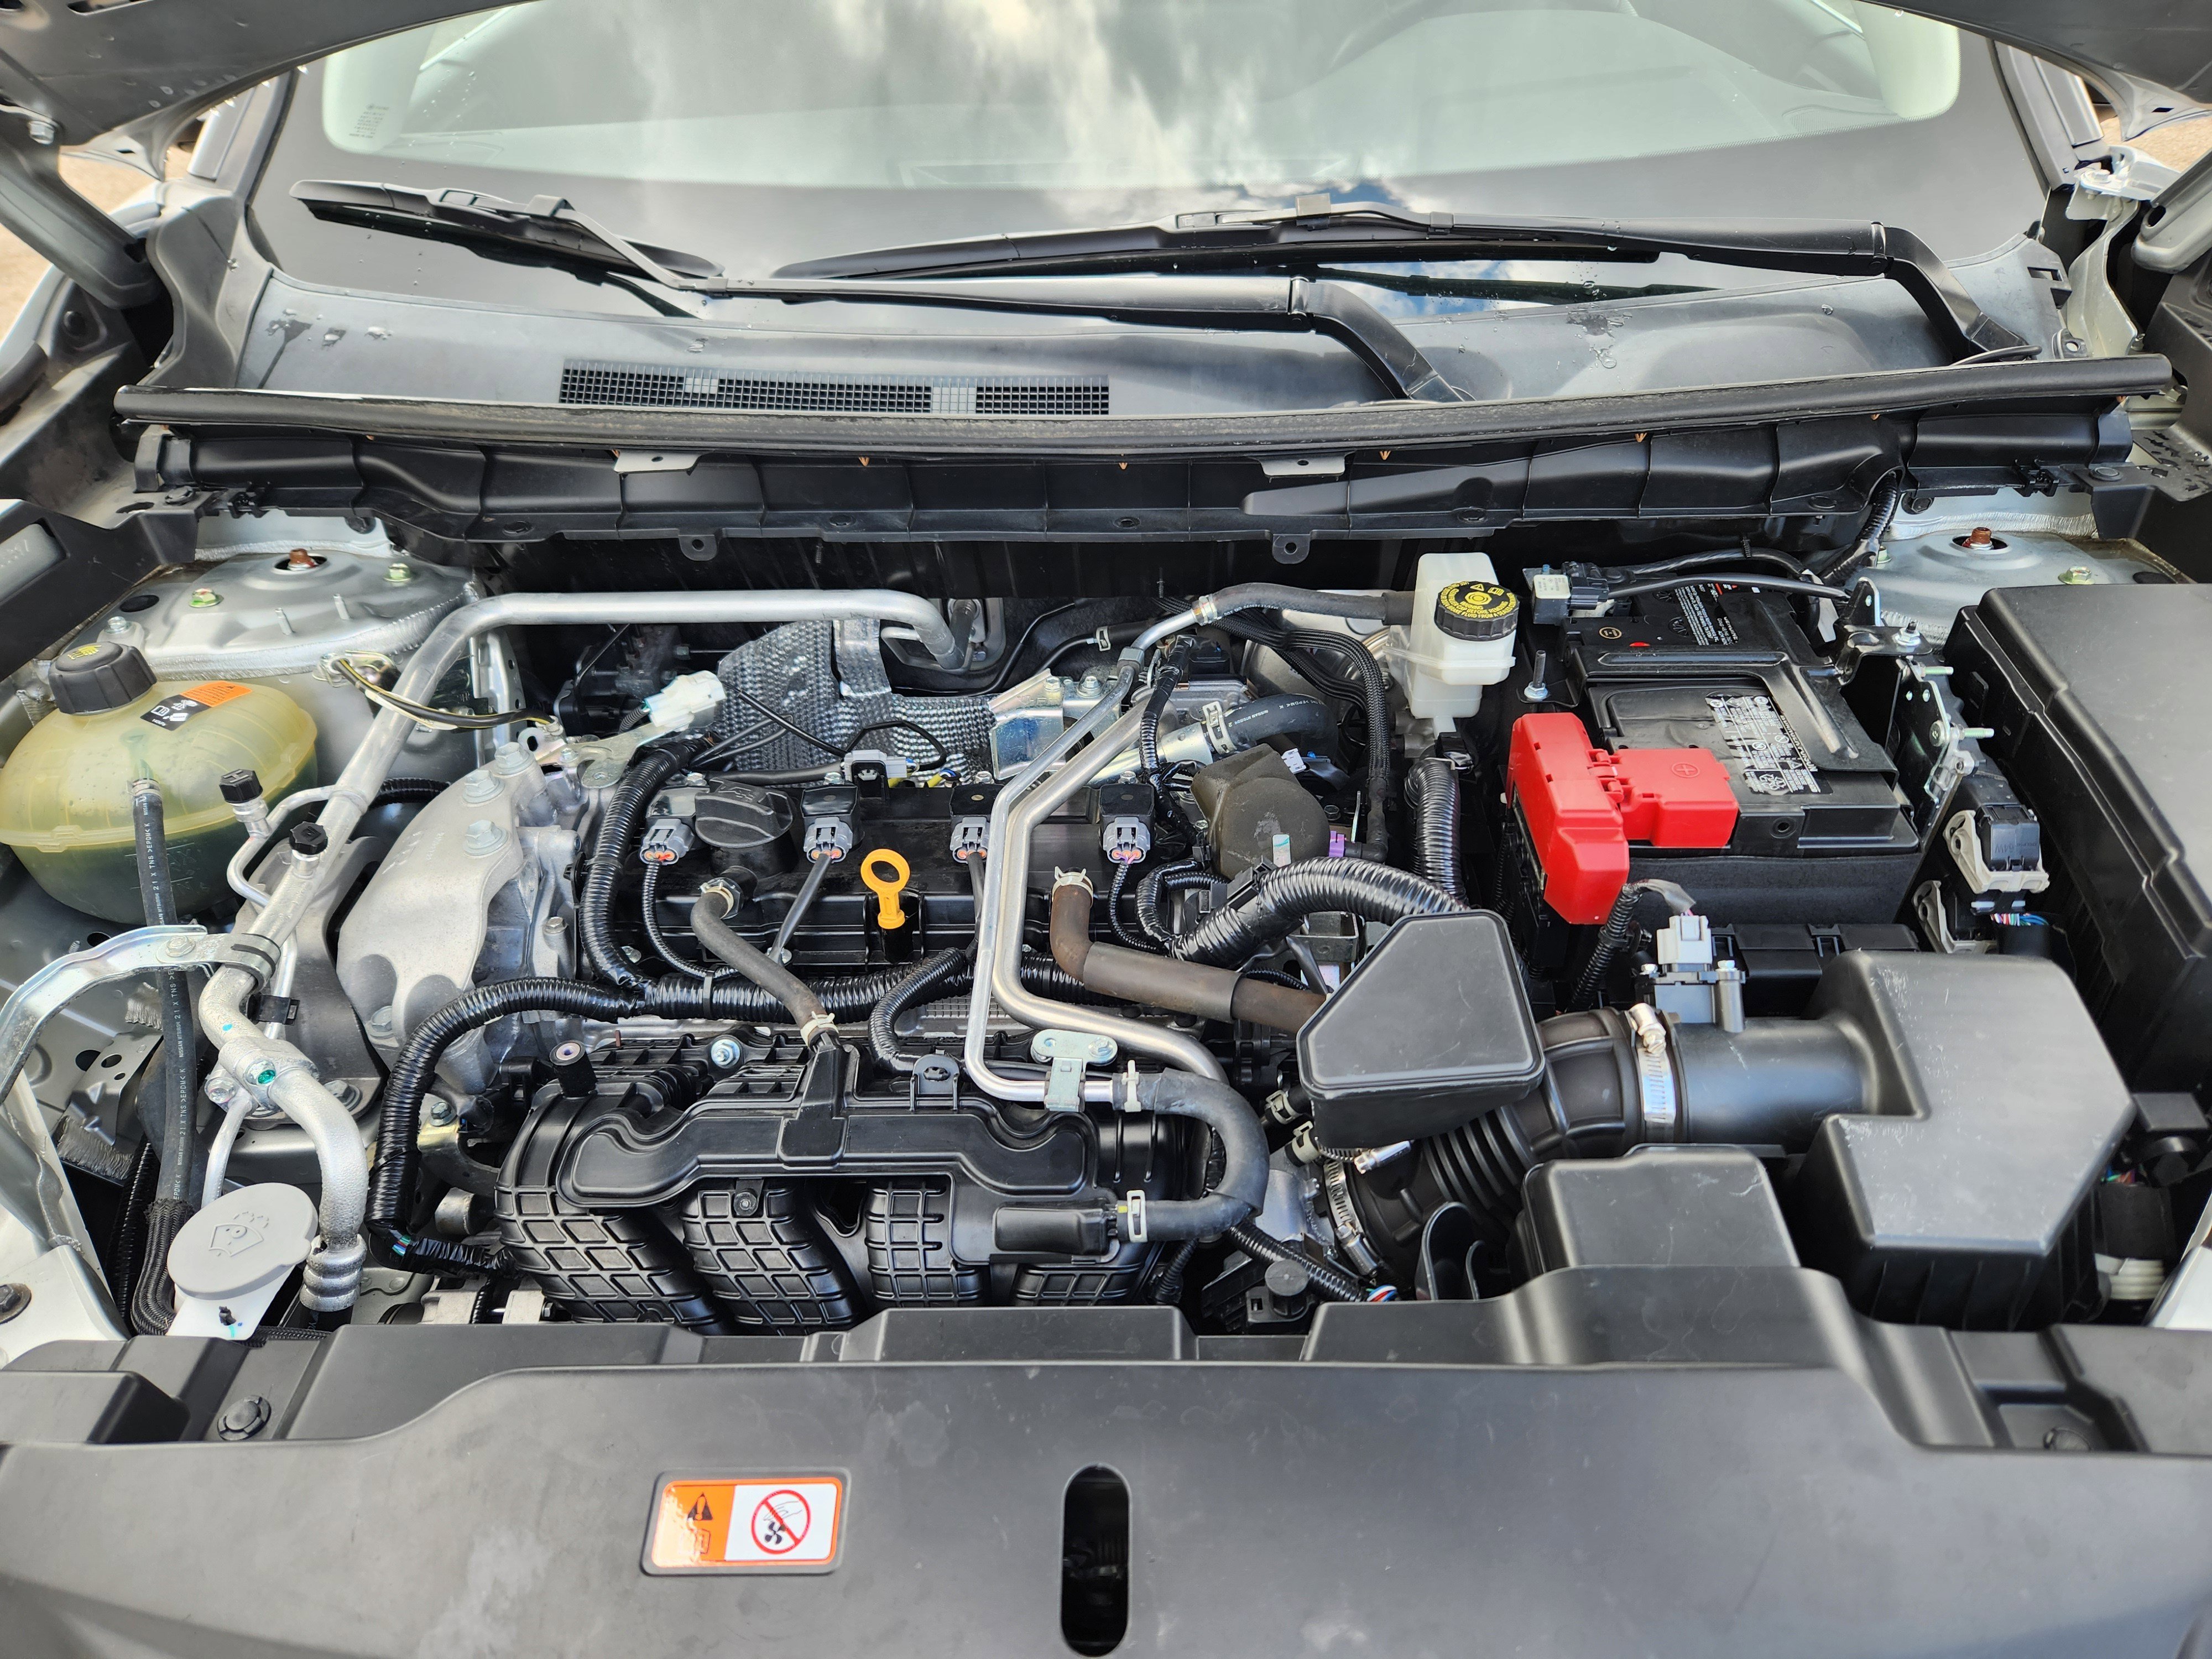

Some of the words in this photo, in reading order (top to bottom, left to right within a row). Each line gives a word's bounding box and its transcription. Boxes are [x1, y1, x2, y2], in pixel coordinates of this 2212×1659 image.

[145, 829, 153, 853] >EPDM<
[170, 983, 179, 998] TNS
[173, 1179, 181, 1201] EPDM<
